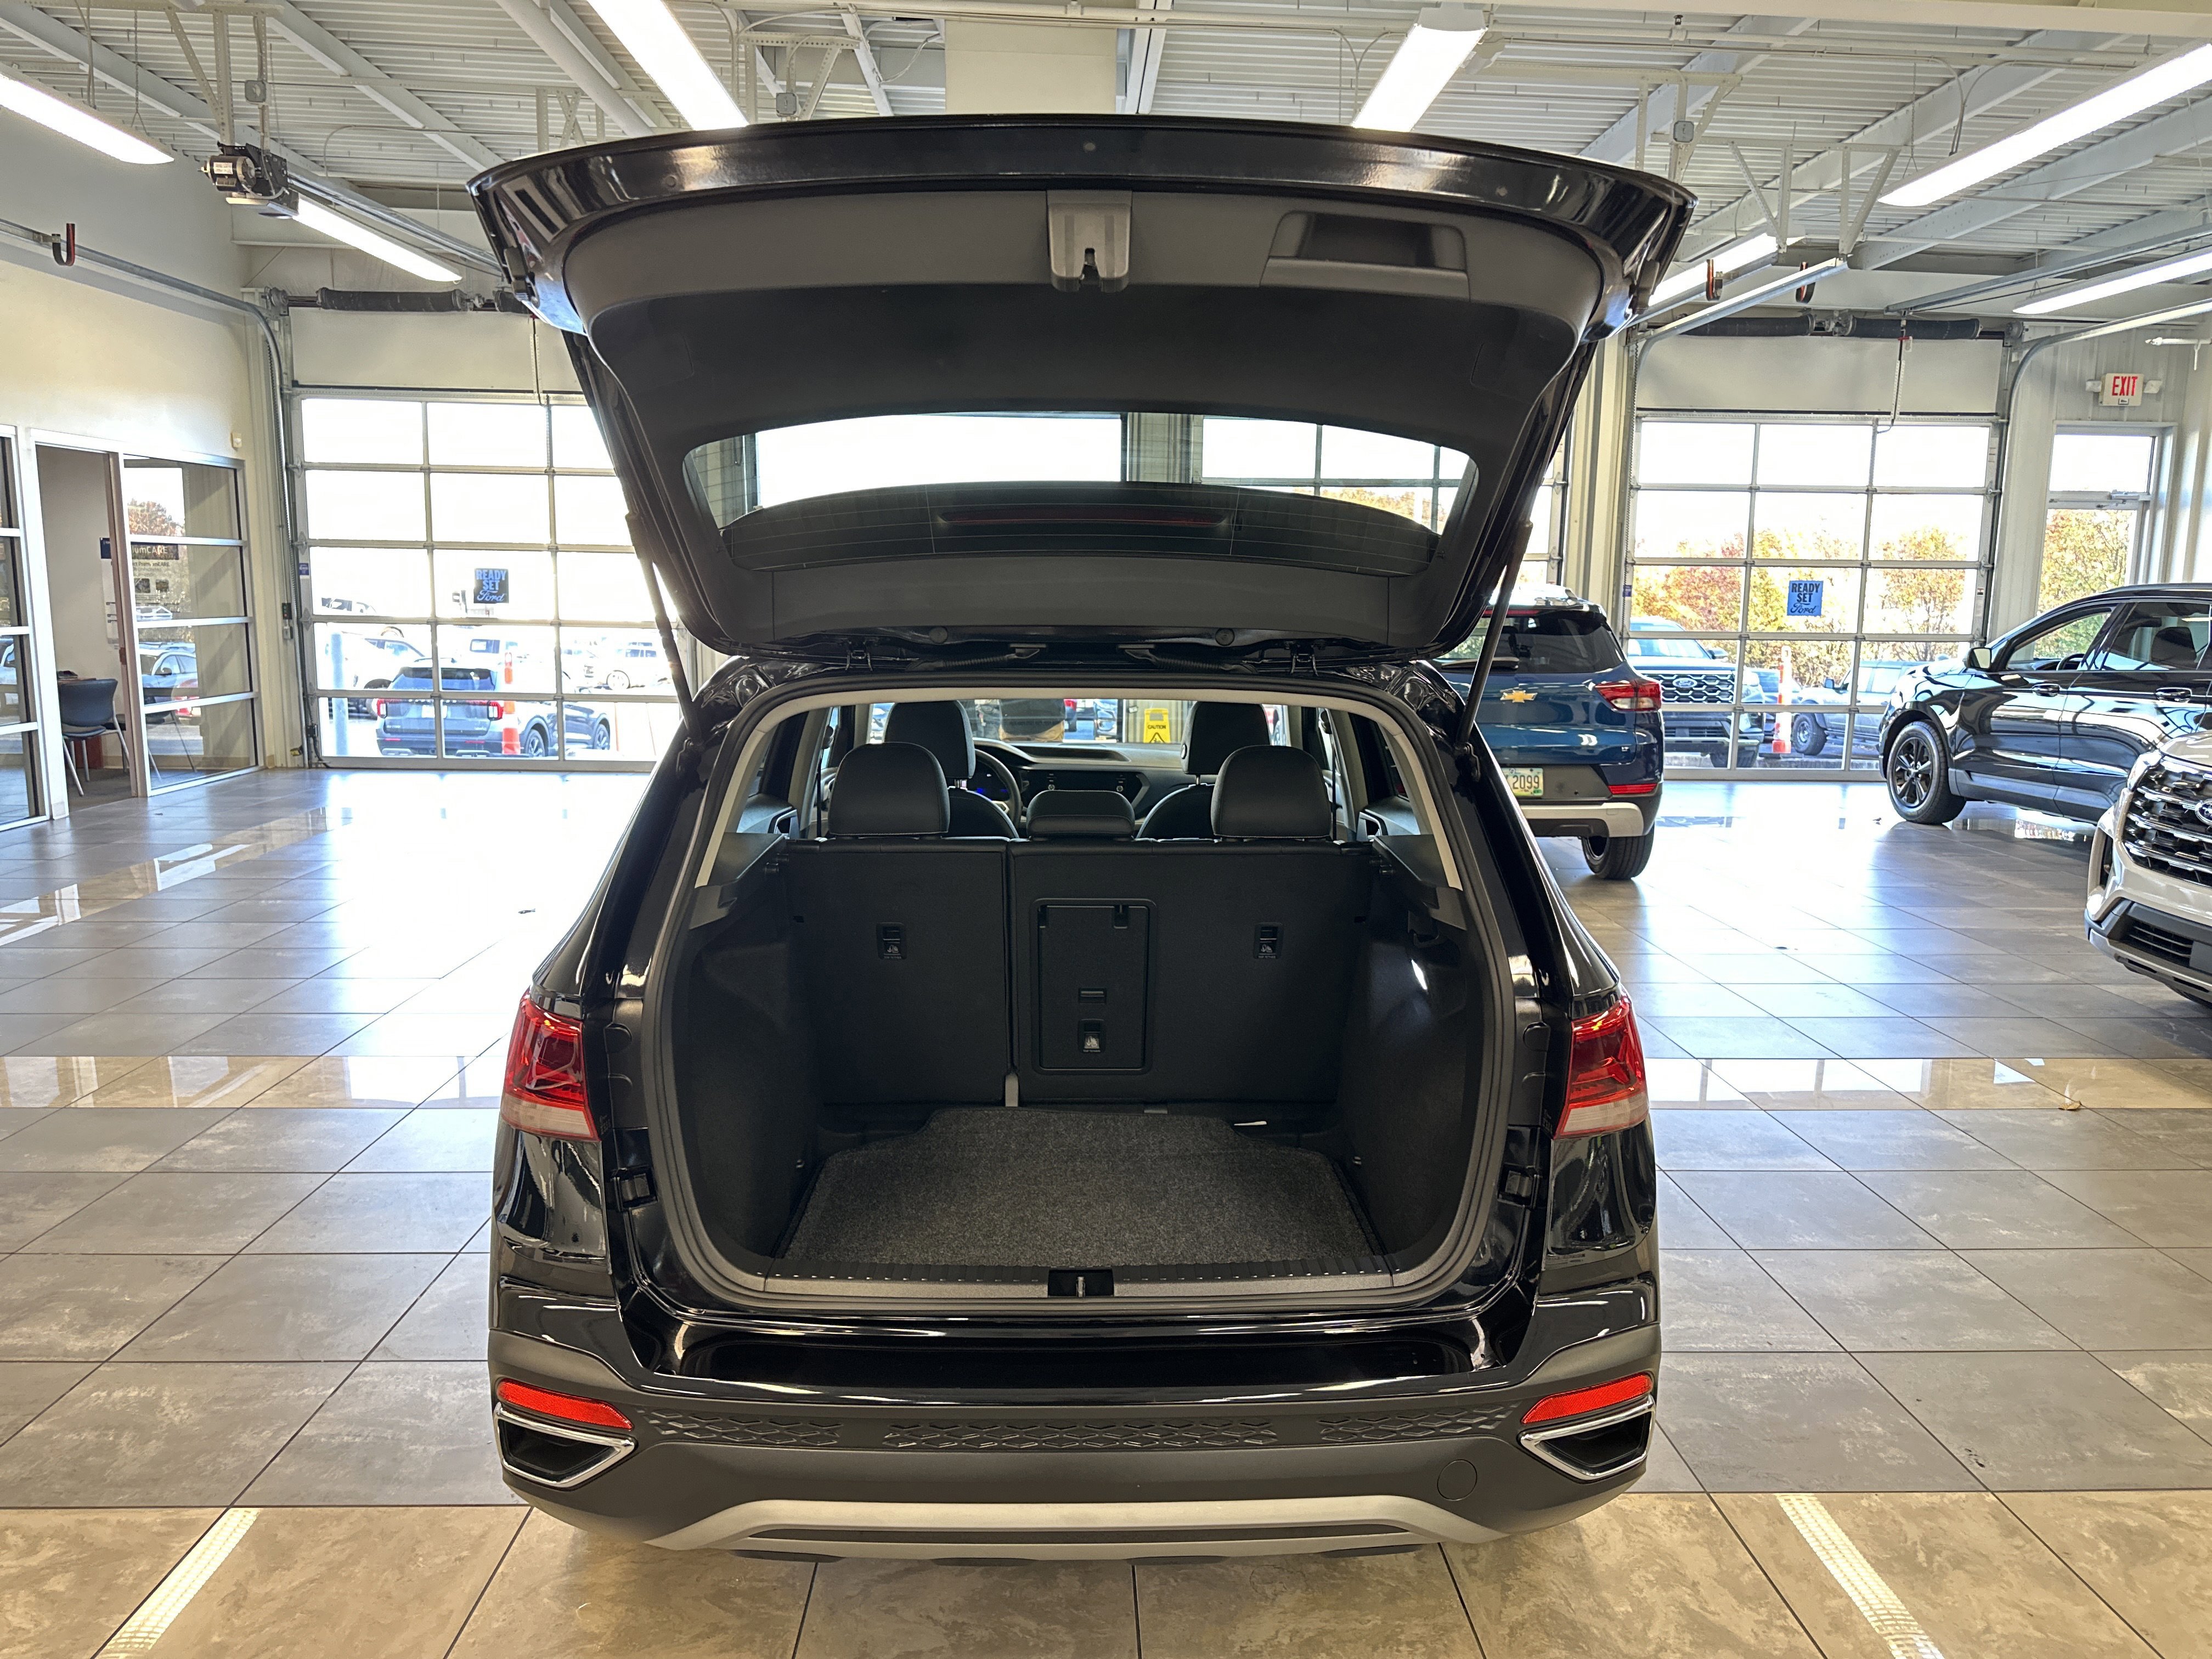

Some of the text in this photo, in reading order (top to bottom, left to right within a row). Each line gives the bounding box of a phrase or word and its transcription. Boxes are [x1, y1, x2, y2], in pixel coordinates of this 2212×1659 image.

[2112, 376, 2138, 396] EXIT
[476, 569, 506, 580] READY
[483, 580, 500, 590] SET
[1791, 583, 1820, 593] READY
[477, 590, 505, 602] Ford
[1797, 593, 1813, 602] SET
[1790, 602, 1817, 613] Ford
[1513, 775, 1539, 789] 2099
